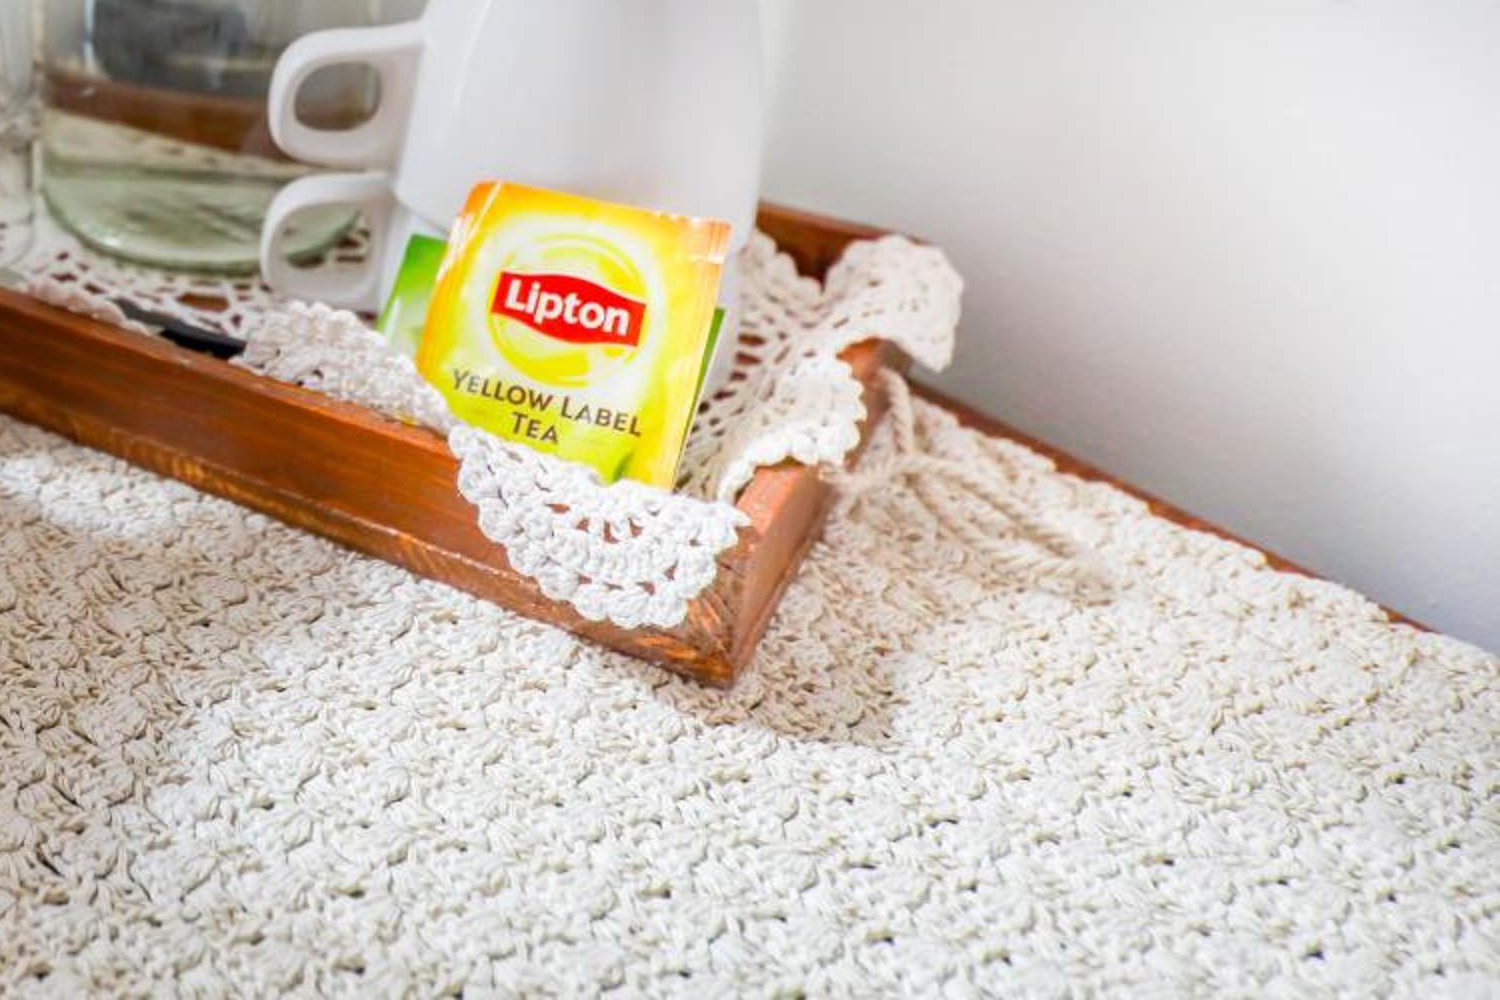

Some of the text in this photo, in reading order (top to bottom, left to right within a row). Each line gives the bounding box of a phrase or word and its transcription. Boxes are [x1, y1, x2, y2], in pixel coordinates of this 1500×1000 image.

[504, 279, 629, 336] Lipton
[452, 370, 642, 437] YELLOW LABEL
[511, 411, 559, 445] TEA
